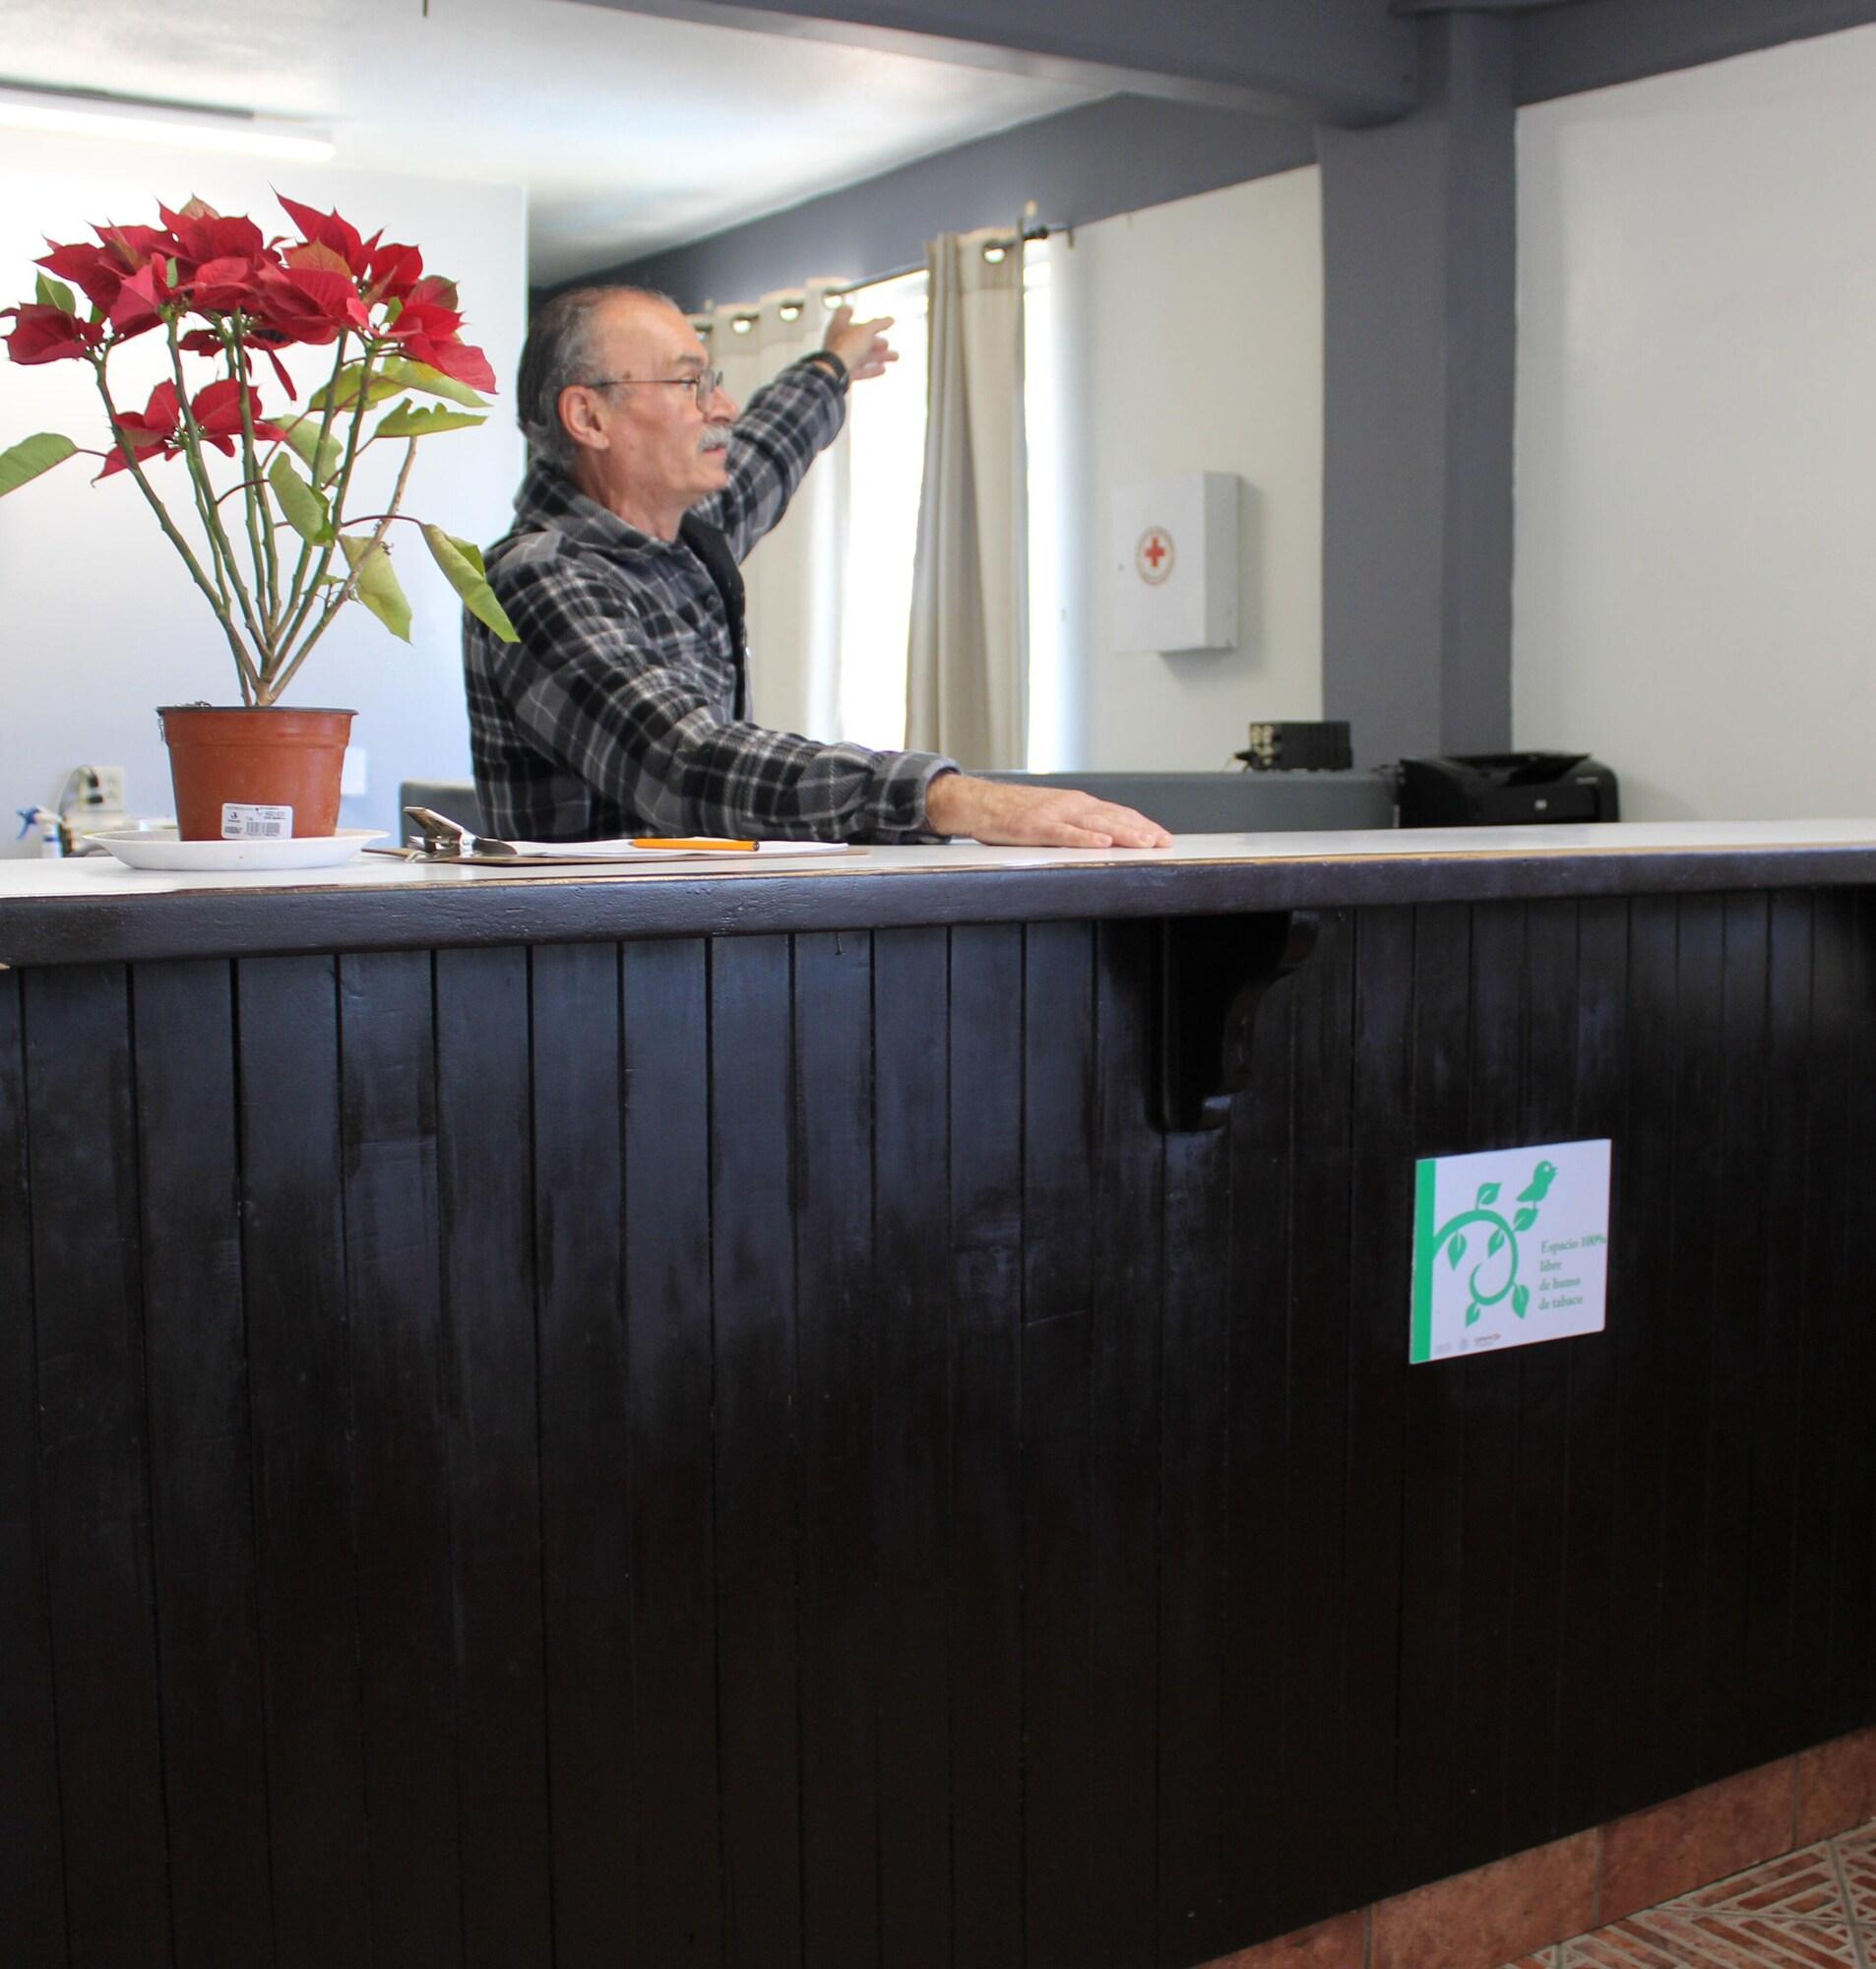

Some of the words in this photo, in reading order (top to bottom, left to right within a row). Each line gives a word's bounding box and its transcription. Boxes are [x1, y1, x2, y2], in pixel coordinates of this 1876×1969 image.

[1541, 1238, 1579, 1255] Espacio
[1581, 1234, 1607, 1248] 100%
[1539, 1259, 1562, 1272] libre
[1539, 1278, 1551, 1291] de
[1552, 1277, 1581, 1290] humo
[1538, 1297, 1550, 1309] de
[1552, 1295, 1583, 1308] tabaco
